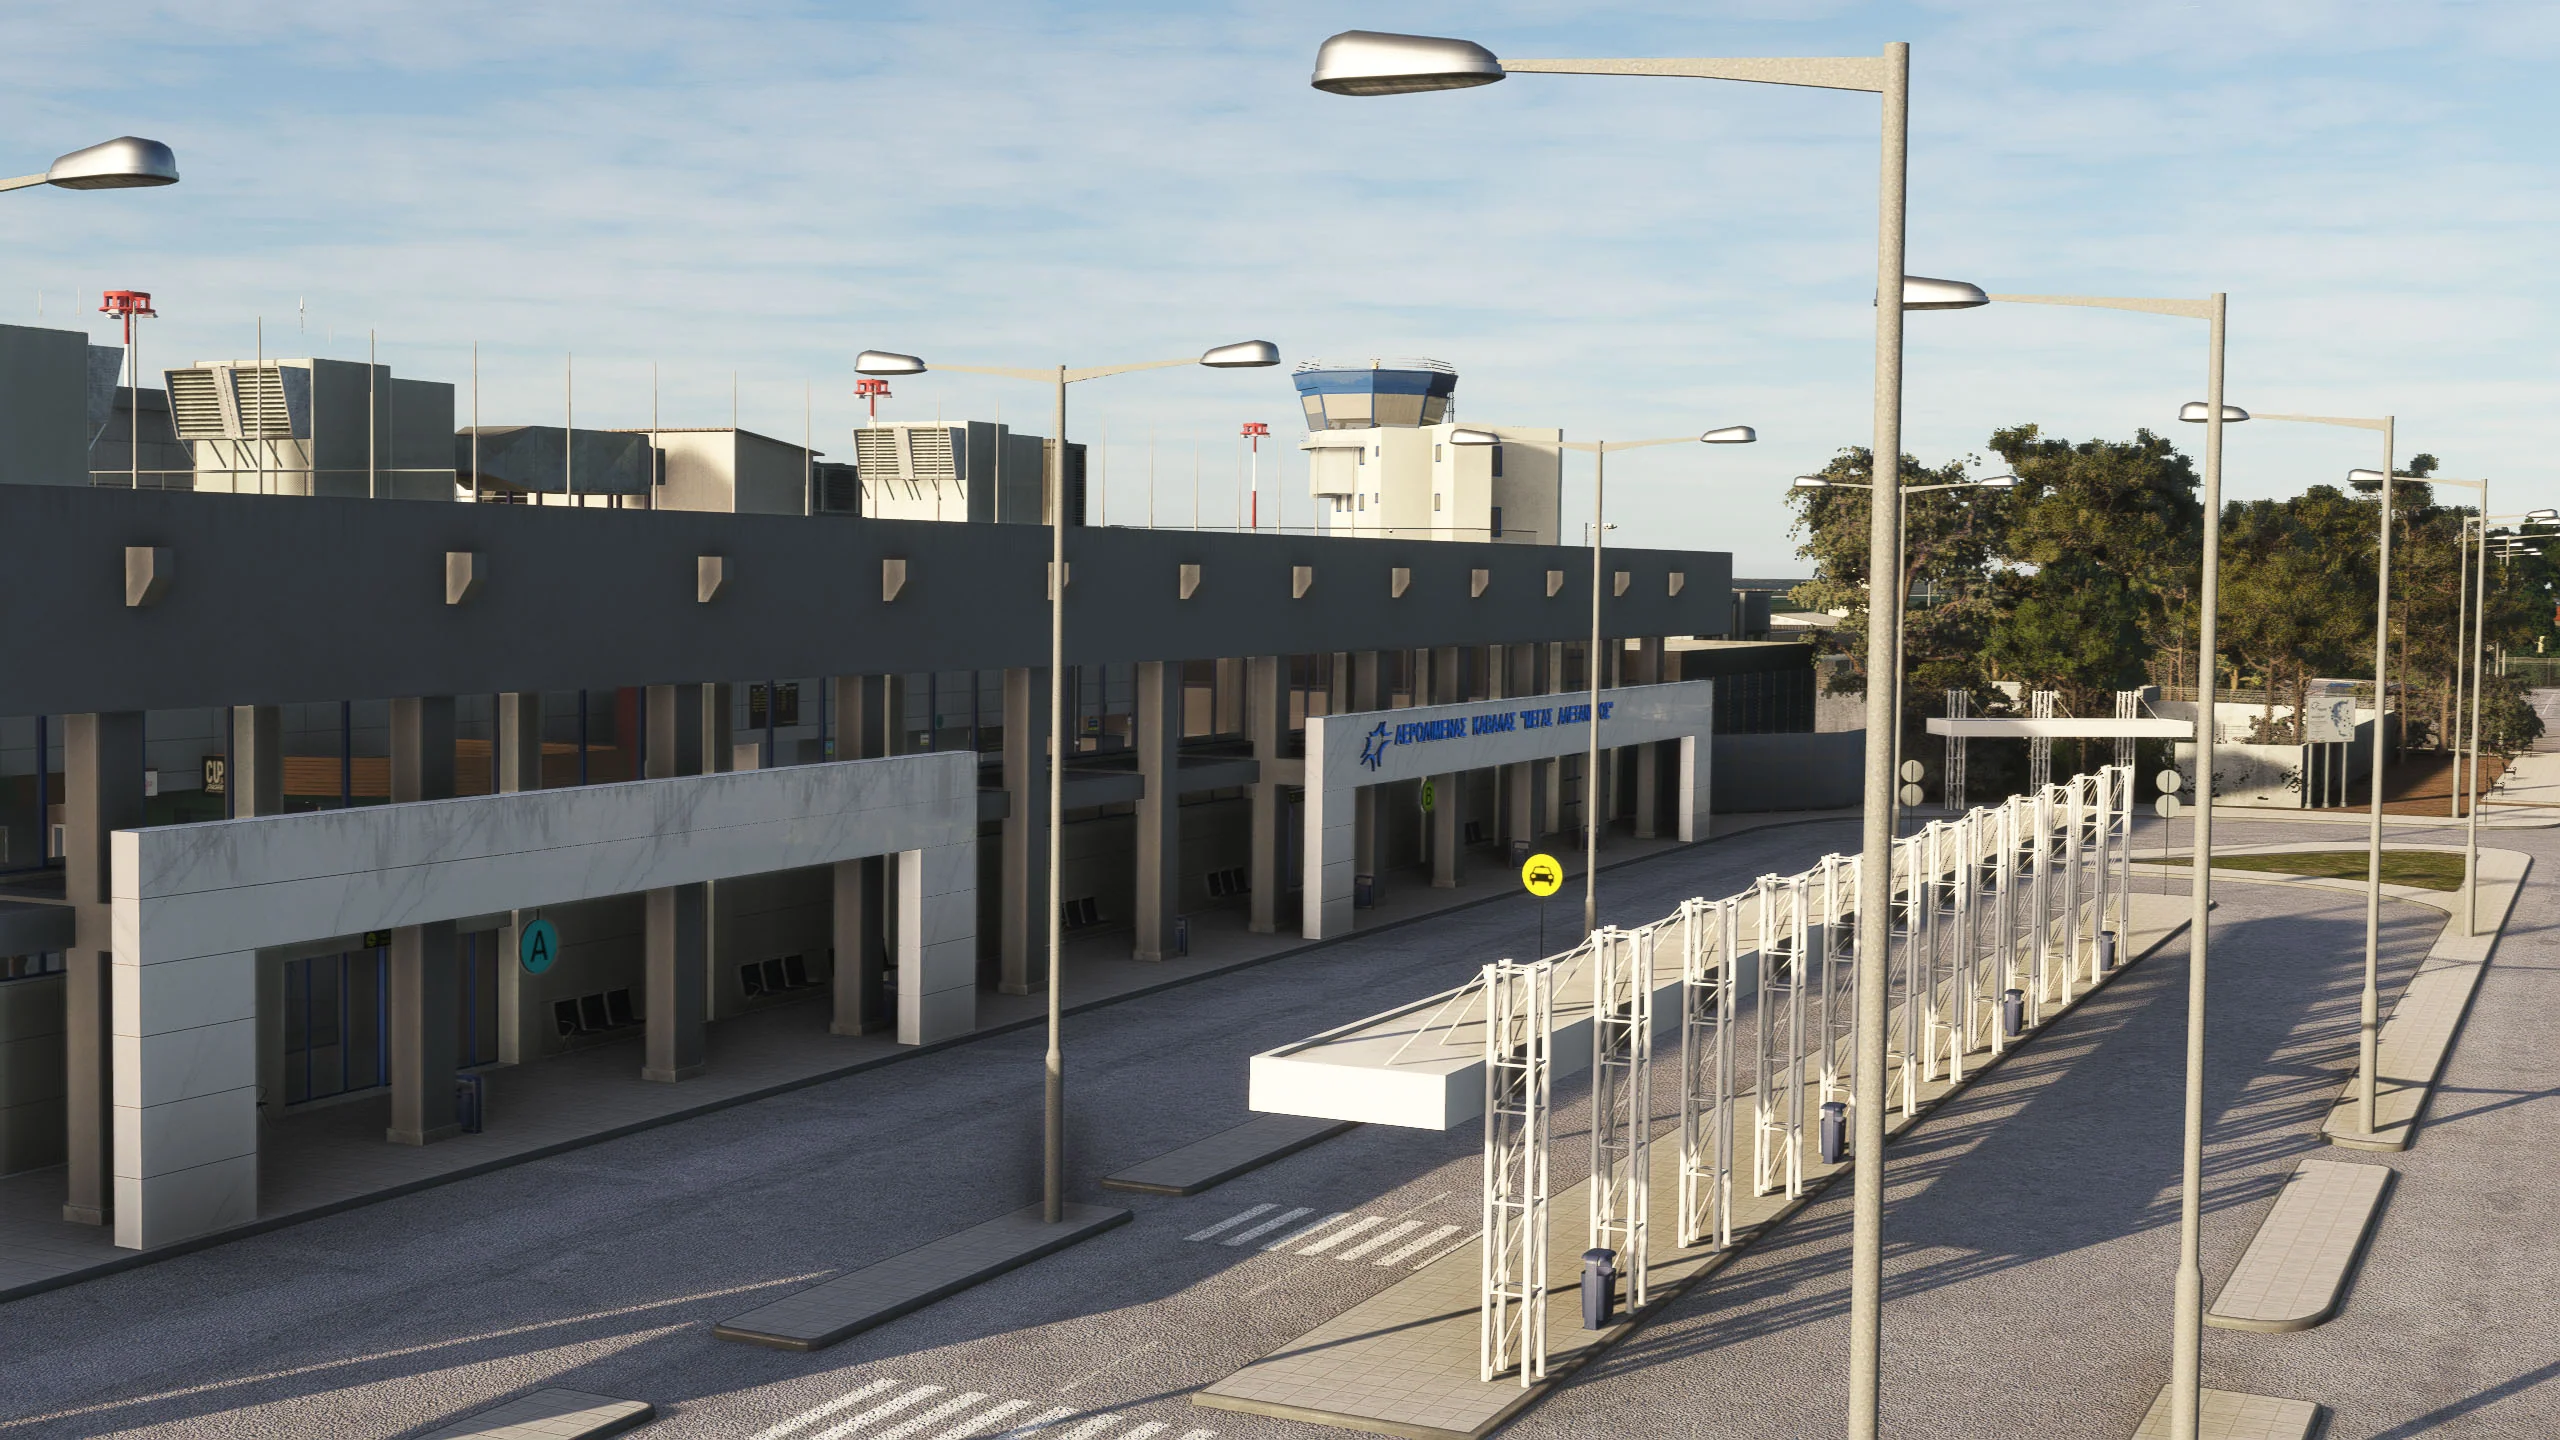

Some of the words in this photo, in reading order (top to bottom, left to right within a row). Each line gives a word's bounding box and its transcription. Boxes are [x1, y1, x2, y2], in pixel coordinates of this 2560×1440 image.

[1472, 712, 1516, 735] ΚΑΒΑΛΑΣ
[1426, 787, 1433, 806] B
[530, 930, 548, 963] A
